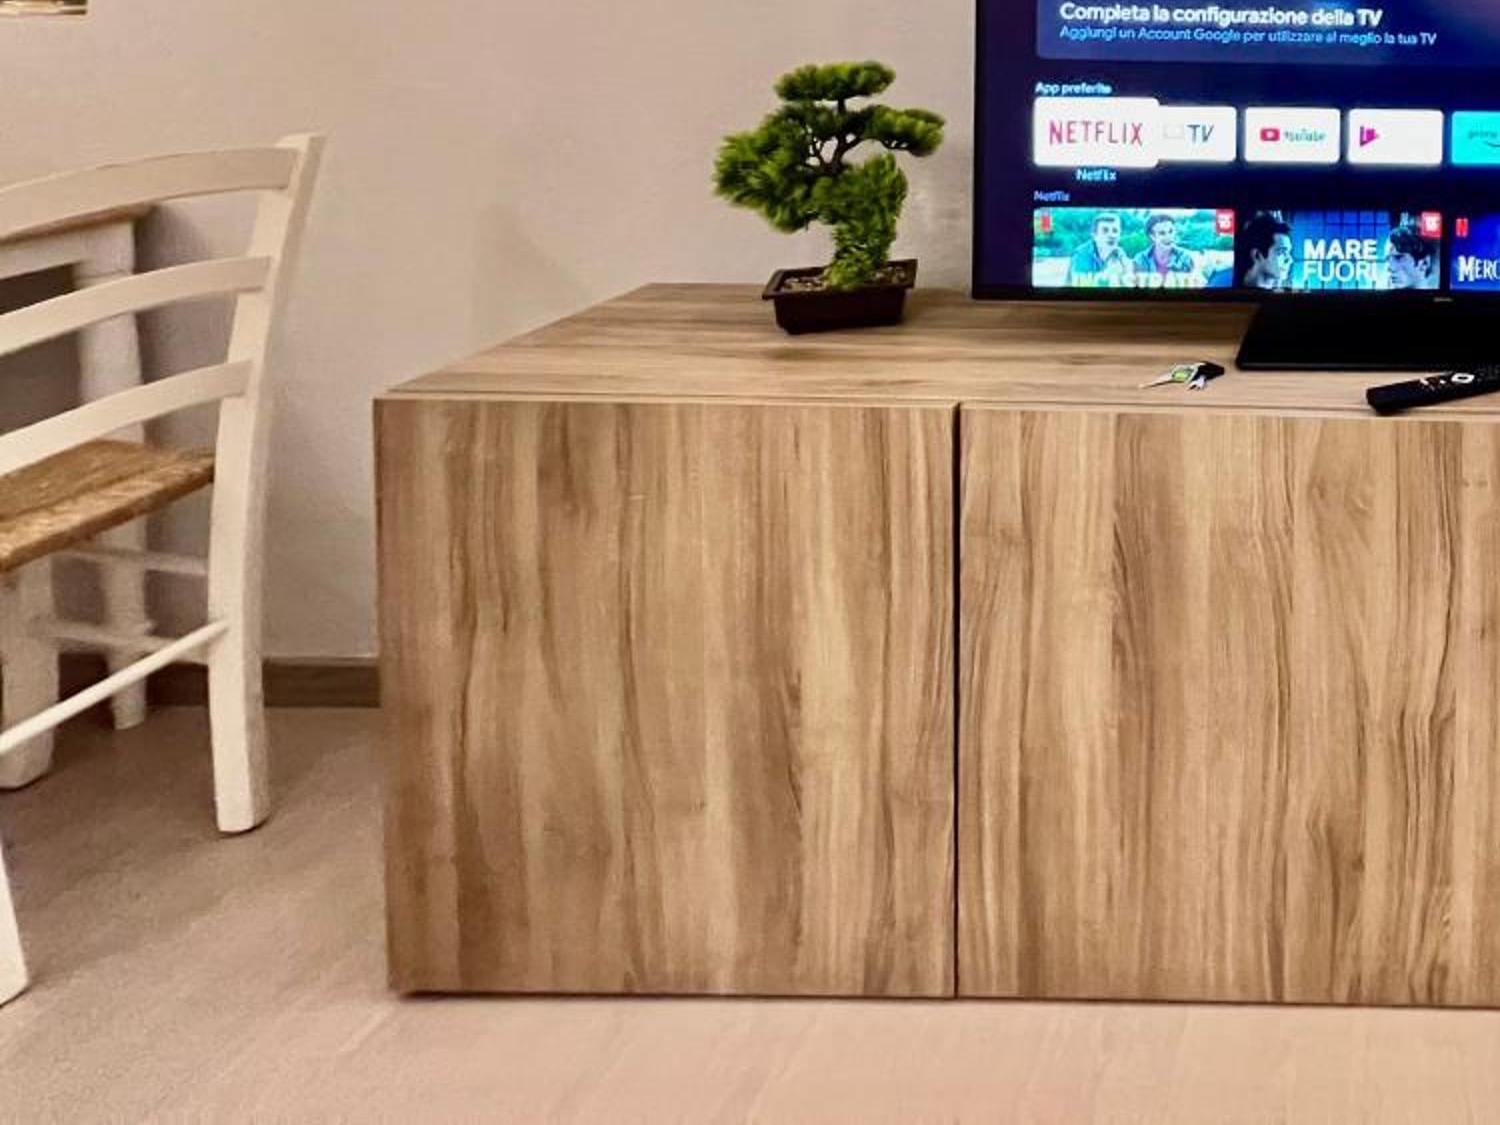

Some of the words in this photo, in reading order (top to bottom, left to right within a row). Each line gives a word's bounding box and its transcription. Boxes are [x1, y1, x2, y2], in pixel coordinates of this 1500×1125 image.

[1060, 2, 1151, 24] Completa
[1153, 4, 1170, 22] la
[1172, 5, 1309, 28] configurazione
[1311, 9, 1355, 26] della
[1356, 9, 1384, 27] TV
[1060, 25, 1117, 41] Aggiungi
[1118, 28, 1135, 39] un
[1137, 27, 1191, 40] Account
[1193, 28, 1241, 44] Google
[1243, 31, 1267, 46] per
[1268, 30, 1323, 44] utilizzare
[1339, 32, 1383, 46] meglio
[1383, 33, 1396, 44] la
[1397, 33, 1419, 45] tua
[1420, 33, 1437, 45] TV
[1035, 82, 1060, 96] App
[1061, 82, 1113, 96] preferite
[1049, 120, 1144, 146] NETFLIX
[1186, 123, 1215, 143] TV
[1075, 168, 1117, 182] Netflix
[1033, 190, 1070, 203] Netflix
[1303, 238, 1378, 260] MARE
[1303, 260, 1379, 283] FUORI
